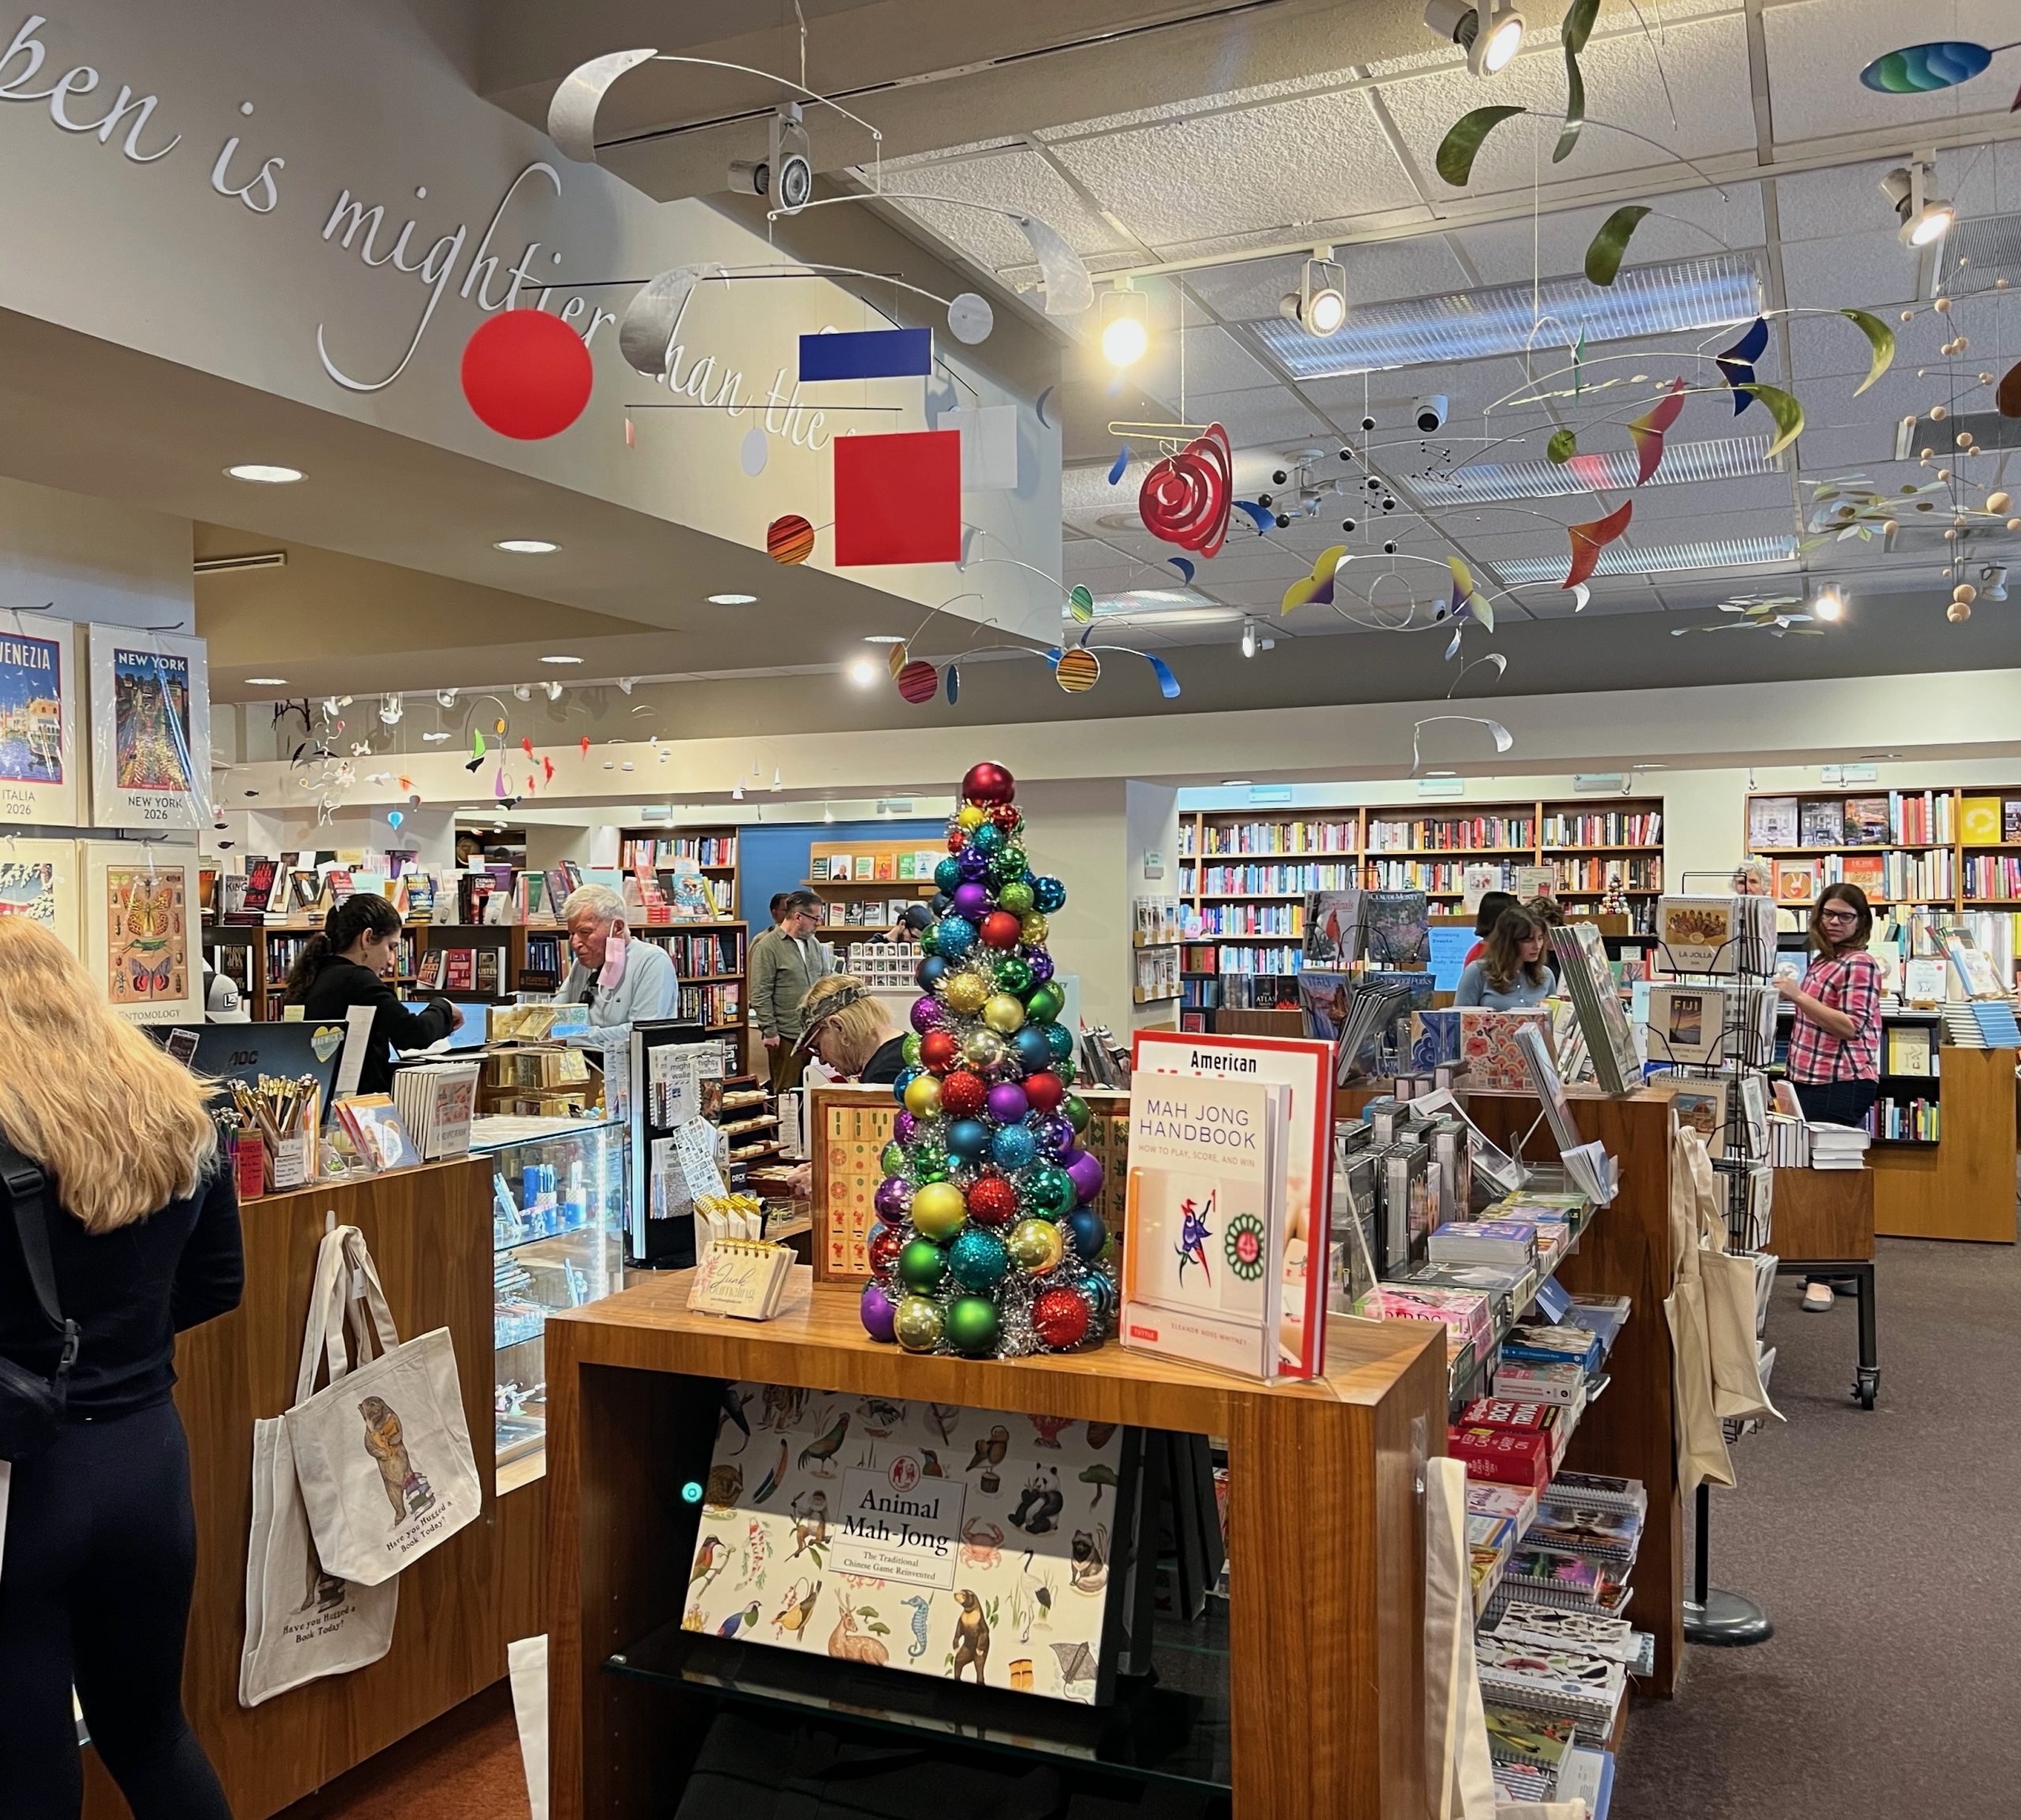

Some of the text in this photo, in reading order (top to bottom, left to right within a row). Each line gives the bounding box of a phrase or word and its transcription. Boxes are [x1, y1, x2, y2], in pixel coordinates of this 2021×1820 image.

[211, 101, 285, 212] is
[118, 653, 186, 672] NEW YORK
[2, 789, 36, 801] ITALIA
[129, 796, 183, 809] NEW YORK
[6, 803, 32, 815] 2026
[144, 809, 168, 820] 2026
[226, 882, 248, 893] KING
[1411, 976, 1433, 985] Parks
[1674, 1000, 1698, 1011] FIJI
[1190, 1050, 1257, 1073] American
[1147, 1099, 1249, 1125] MAH JONG
[1140, 1119, 1256, 1150] HANDBOOK
[1159, 1147, 1168, 1155] TO
[1171, 1148, 1190, 1159] PLAY,
[1193, 1151, 1220, 1163] SCORE,
[1222, 1155, 1238, 1165] AND
[1240, 1157, 1255, 1167] WIN
[731, 1174, 746, 1183] DECK
[711, 1263, 756, 1289] Junk
[1171, 1323, 1198, 1335] ELEANOR
[1487, 1402, 1515, 1421] ROCK
[1511, 1403, 1540, 1425] TRIVIA
[859, 1489, 939, 1519] Animal
[386, 1534, 405, 1551] Have
[406, 1525, 420, 1539] you
[420, 1504, 446, 1526] Hugged
[842, 1515, 951, 1556] Mah-Jong
[400, 1537, 419, 1552] Book
[864, 1551, 919, 1567] The Traditional
[843, 1559, 936, 1579] Chinese Game Reinvented
[283, 1623, 305, 1635] Have
[306, 1618, 321, 1629] you
[324, 1605, 350, 1623] Hugged
[295, 1629, 316, 1643] Book
